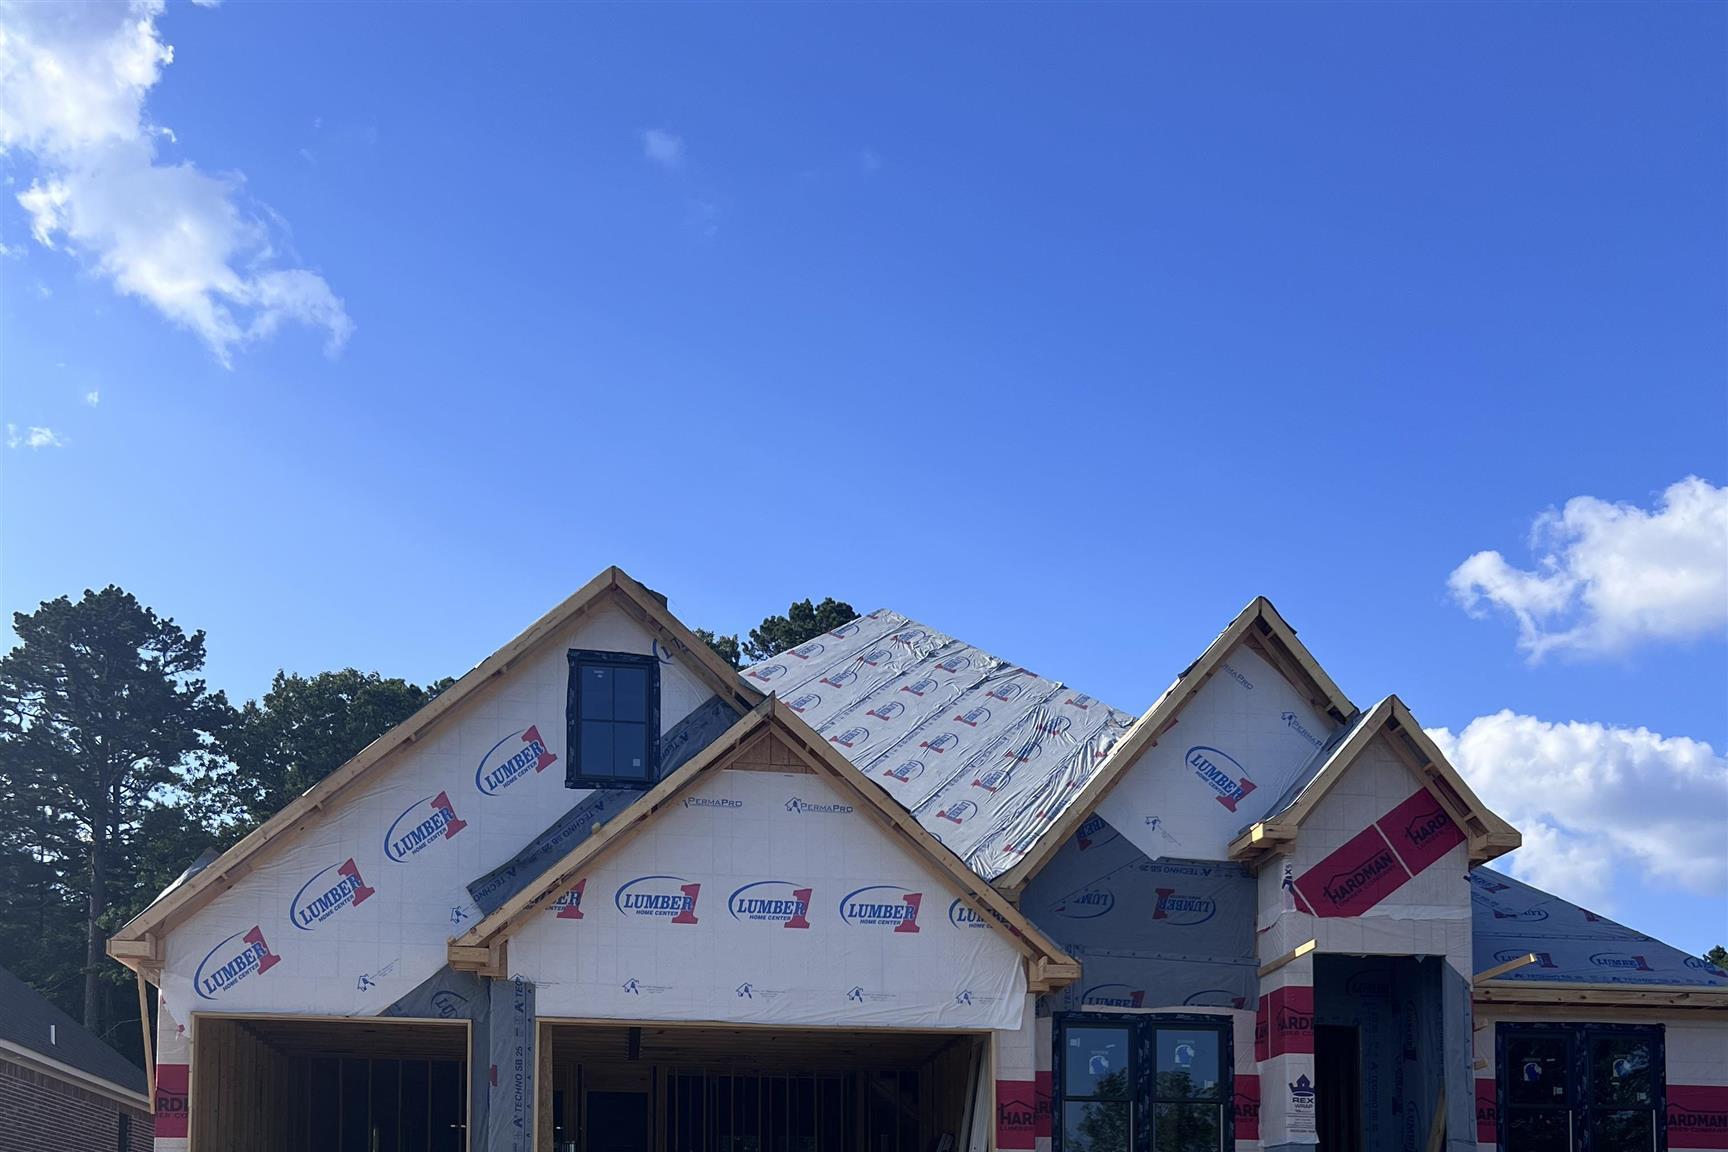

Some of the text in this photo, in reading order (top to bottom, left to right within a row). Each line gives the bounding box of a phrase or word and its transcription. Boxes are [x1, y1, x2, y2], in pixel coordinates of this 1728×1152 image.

[485, 741, 546, 791] LUMBER
[1190, 753, 1244, 801] LUMBER
[393, 807, 455, 858] LUMBER
[1411, 811, 1453, 846] HARD
[1325, 851, 1393, 905] HARDMAN
[299, 873, 362, 926] LUMBER
[624, 893, 693, 911] LUMBER
[737, 898, 806, 916] LUMBER
[848, 903, 916, 920] LUMBER
[1158, 898, 1212, 913] LUMBER
[203, 941, 268, 995] LUMBER
[515, 1046, 523, 1057] 25
[515, 1060, 523, 1073] SB
[514, 1074, 523, 1112] TECHNO
[1000, 1111, 1036, 1125] HAR
